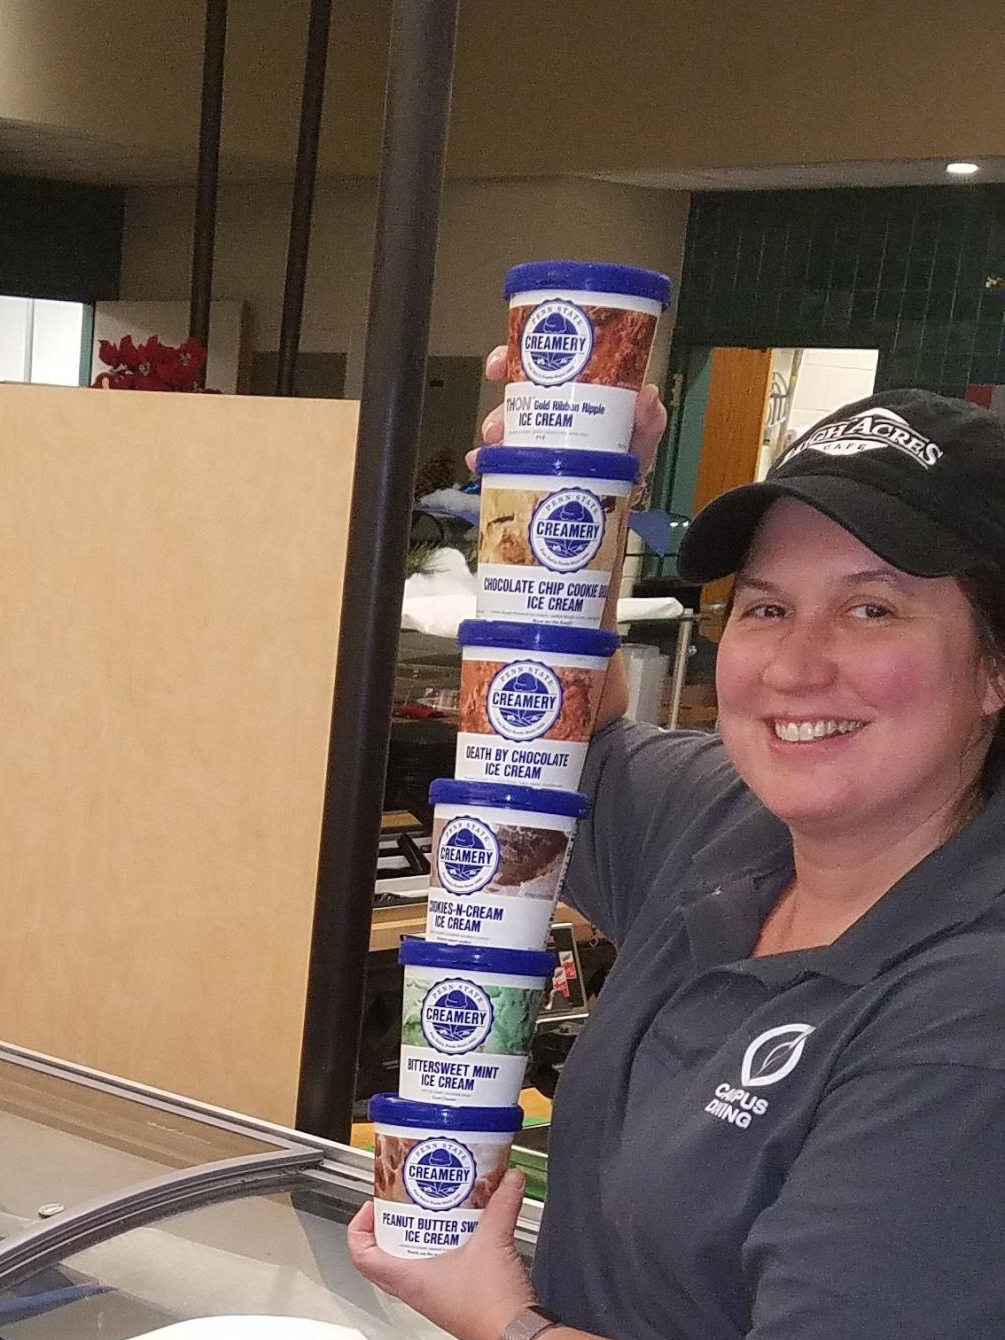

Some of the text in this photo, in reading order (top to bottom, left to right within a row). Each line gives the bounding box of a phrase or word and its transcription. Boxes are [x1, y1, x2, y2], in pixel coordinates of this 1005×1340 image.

[525, 335, 587, 352] CREAMERY
[534, 400, 550, 411] Gold
[581, 402, 606, 416] Ripple
[519, 412, 574, 428] ICE CREAM
[536, 521, 600, 540] CREAMERY
[483, 577, 535, 595] CHOCOLATE
[538, 580, 564, 595] CHIP
[567, 583, 599, 598] COOKIE
[527, 596, 584, 612] ICE CREAM
[492, 691, 557, 710] CREAMERY
[466, 745, 570, 768] DEATH BY CHOCOLATE
[485, 763, 543, 780] ICE CREAM
[440, 846, 494, 865] CREAMERY
[435, 915, 482, 933] ICE CREAM
[432, 983, 484, 1002] PENN STATE
[426, 1007, 487, 1026] CREAMERY
[408, 1058, 499, 1080] BITTERSWEET MINT
[421, 1074, 475, 1091] ICE CREAM
[414, 1142, 467, 1161] PENN STATE
[408, 1164, 470, 1183] CREAMERY
[383, 1212, 415, 1229] PEANUT
[418, 1218, 458, 1233] BUTTER
[405, 1231, 460, 1246] ICE CREAM
